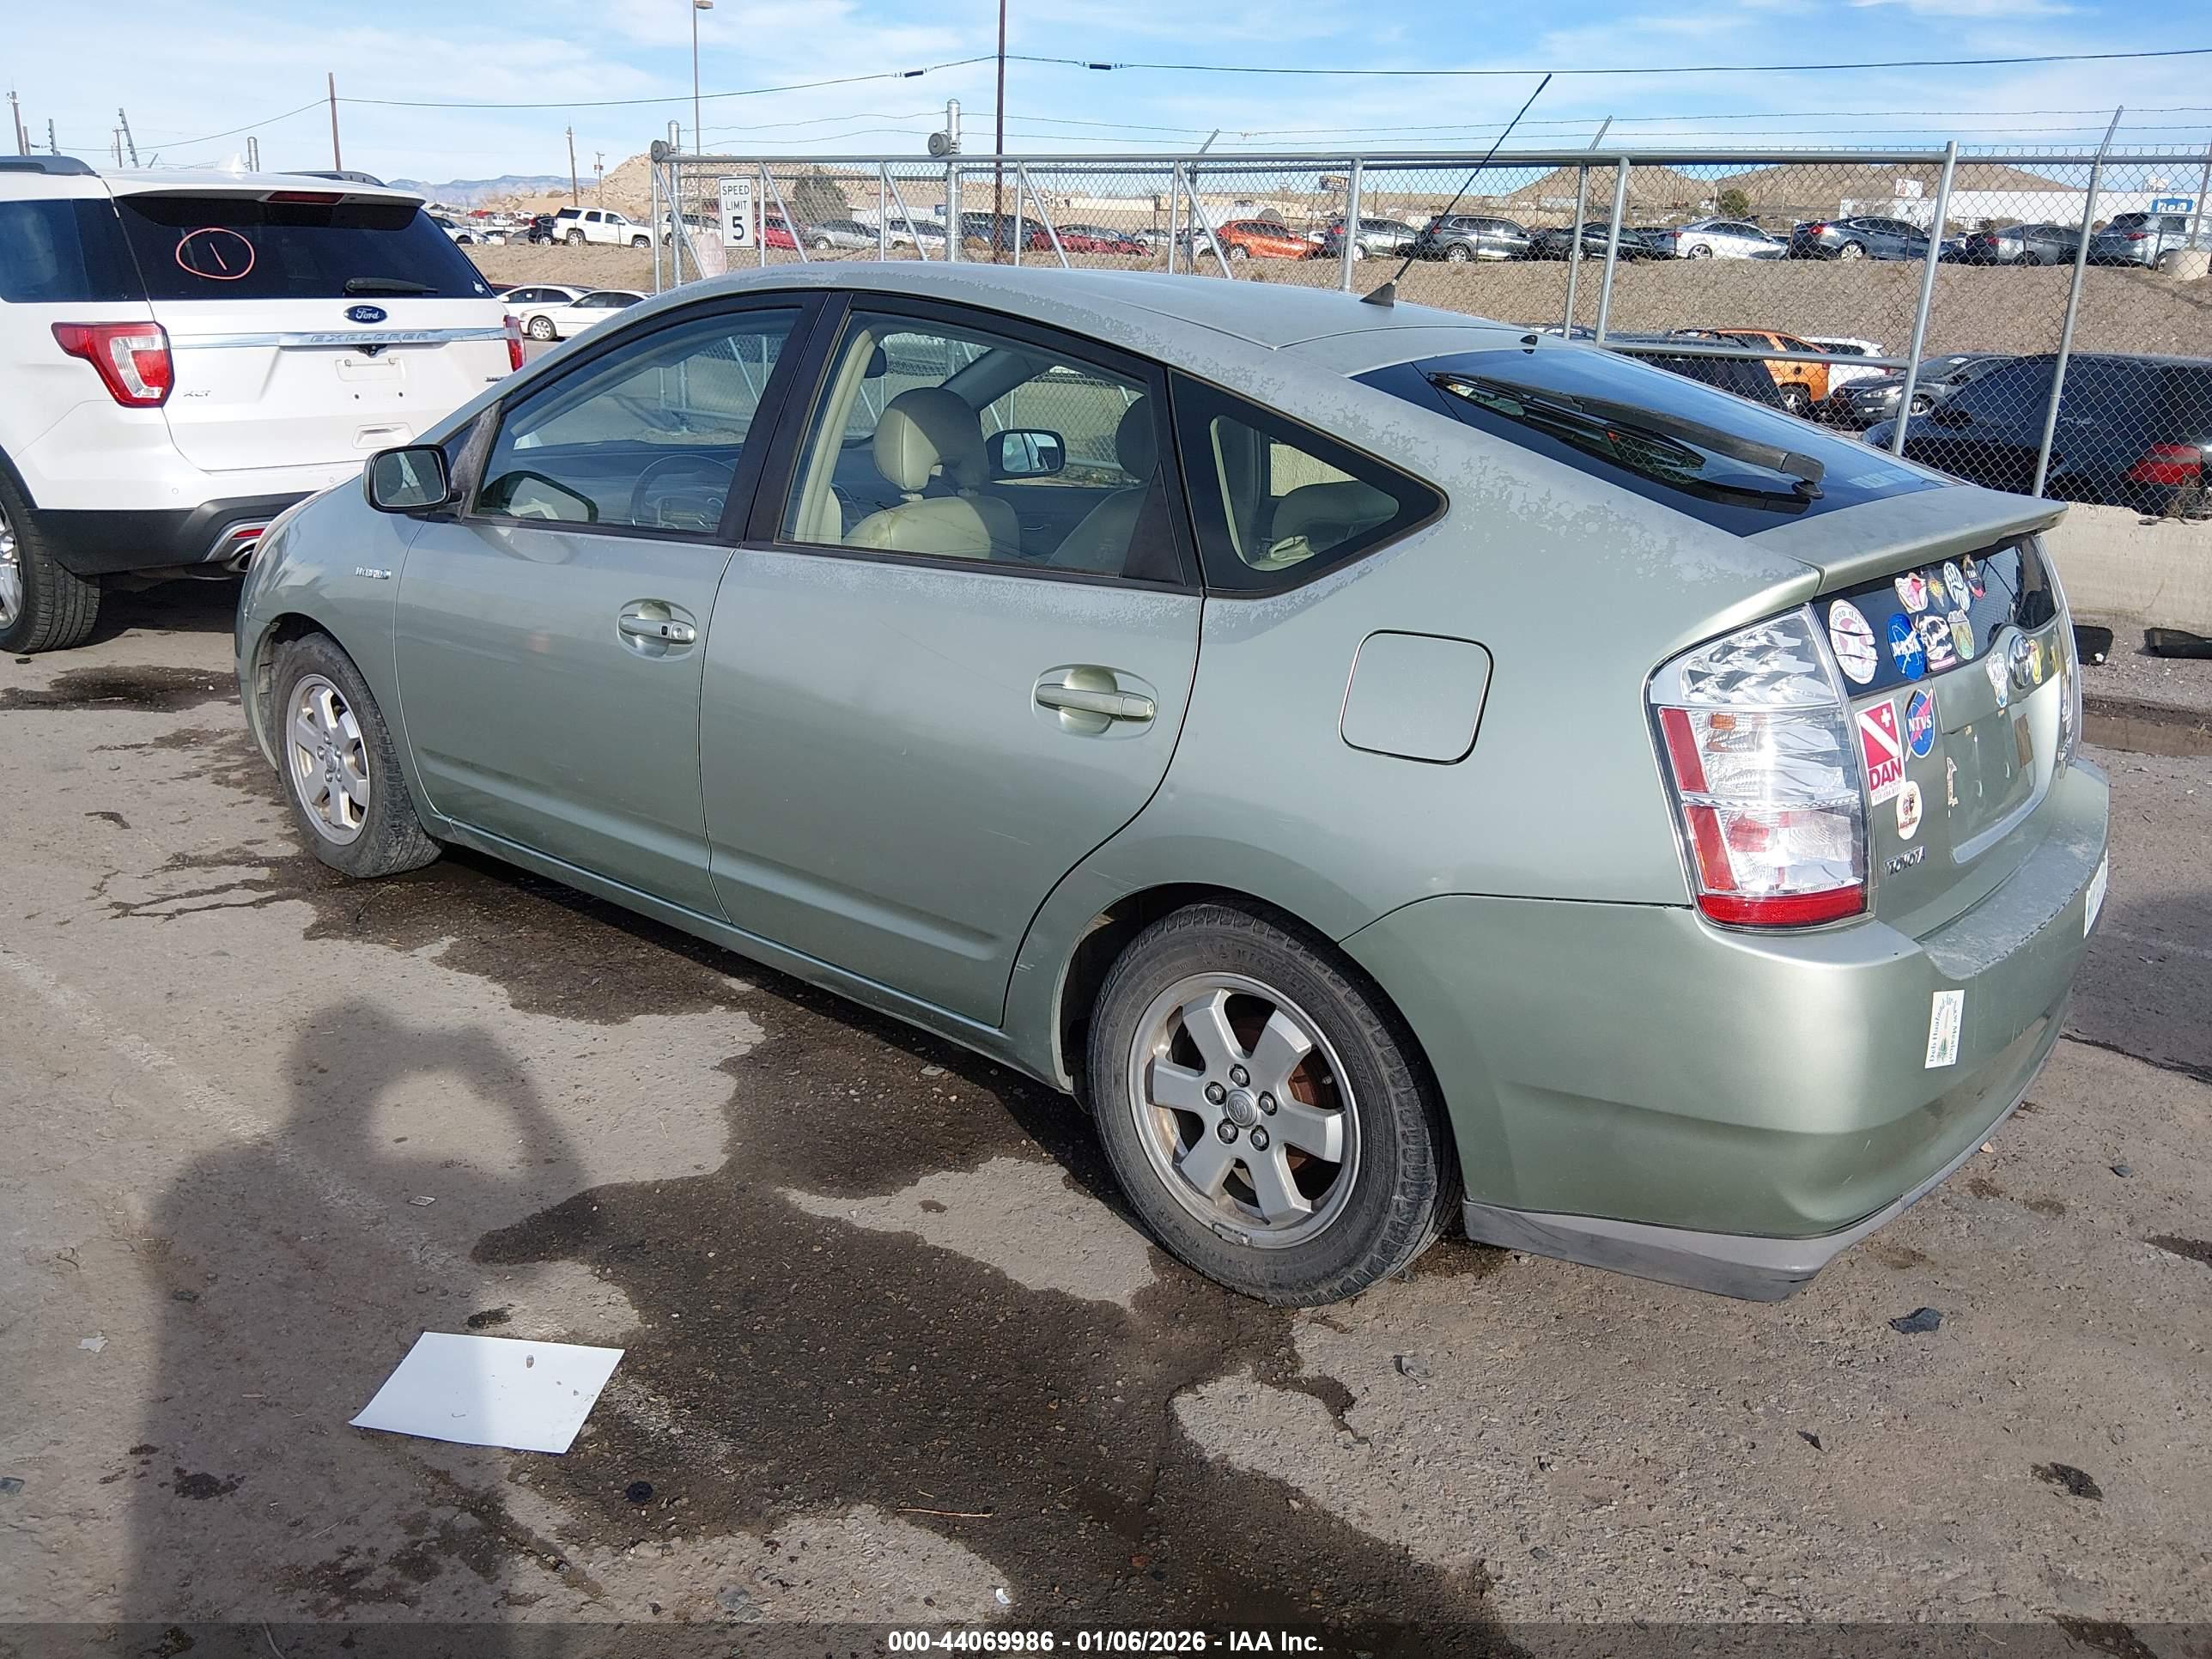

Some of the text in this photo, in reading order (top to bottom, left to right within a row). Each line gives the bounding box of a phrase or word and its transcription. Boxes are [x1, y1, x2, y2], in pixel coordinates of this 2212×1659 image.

[722, 185, 750, 196] SPEED
[726, 200, 748, 211] LIMIT
[732, 216, 744, 240] 5
[356, 307, 380, 320] Ford
[310, 331, 429, 343] EXPLORER
[1908, 714, 1933, 732] NTVS
[1869, 757, 1903, 791] DAN
[1886, 846, 1925, 876] TOYOTA
